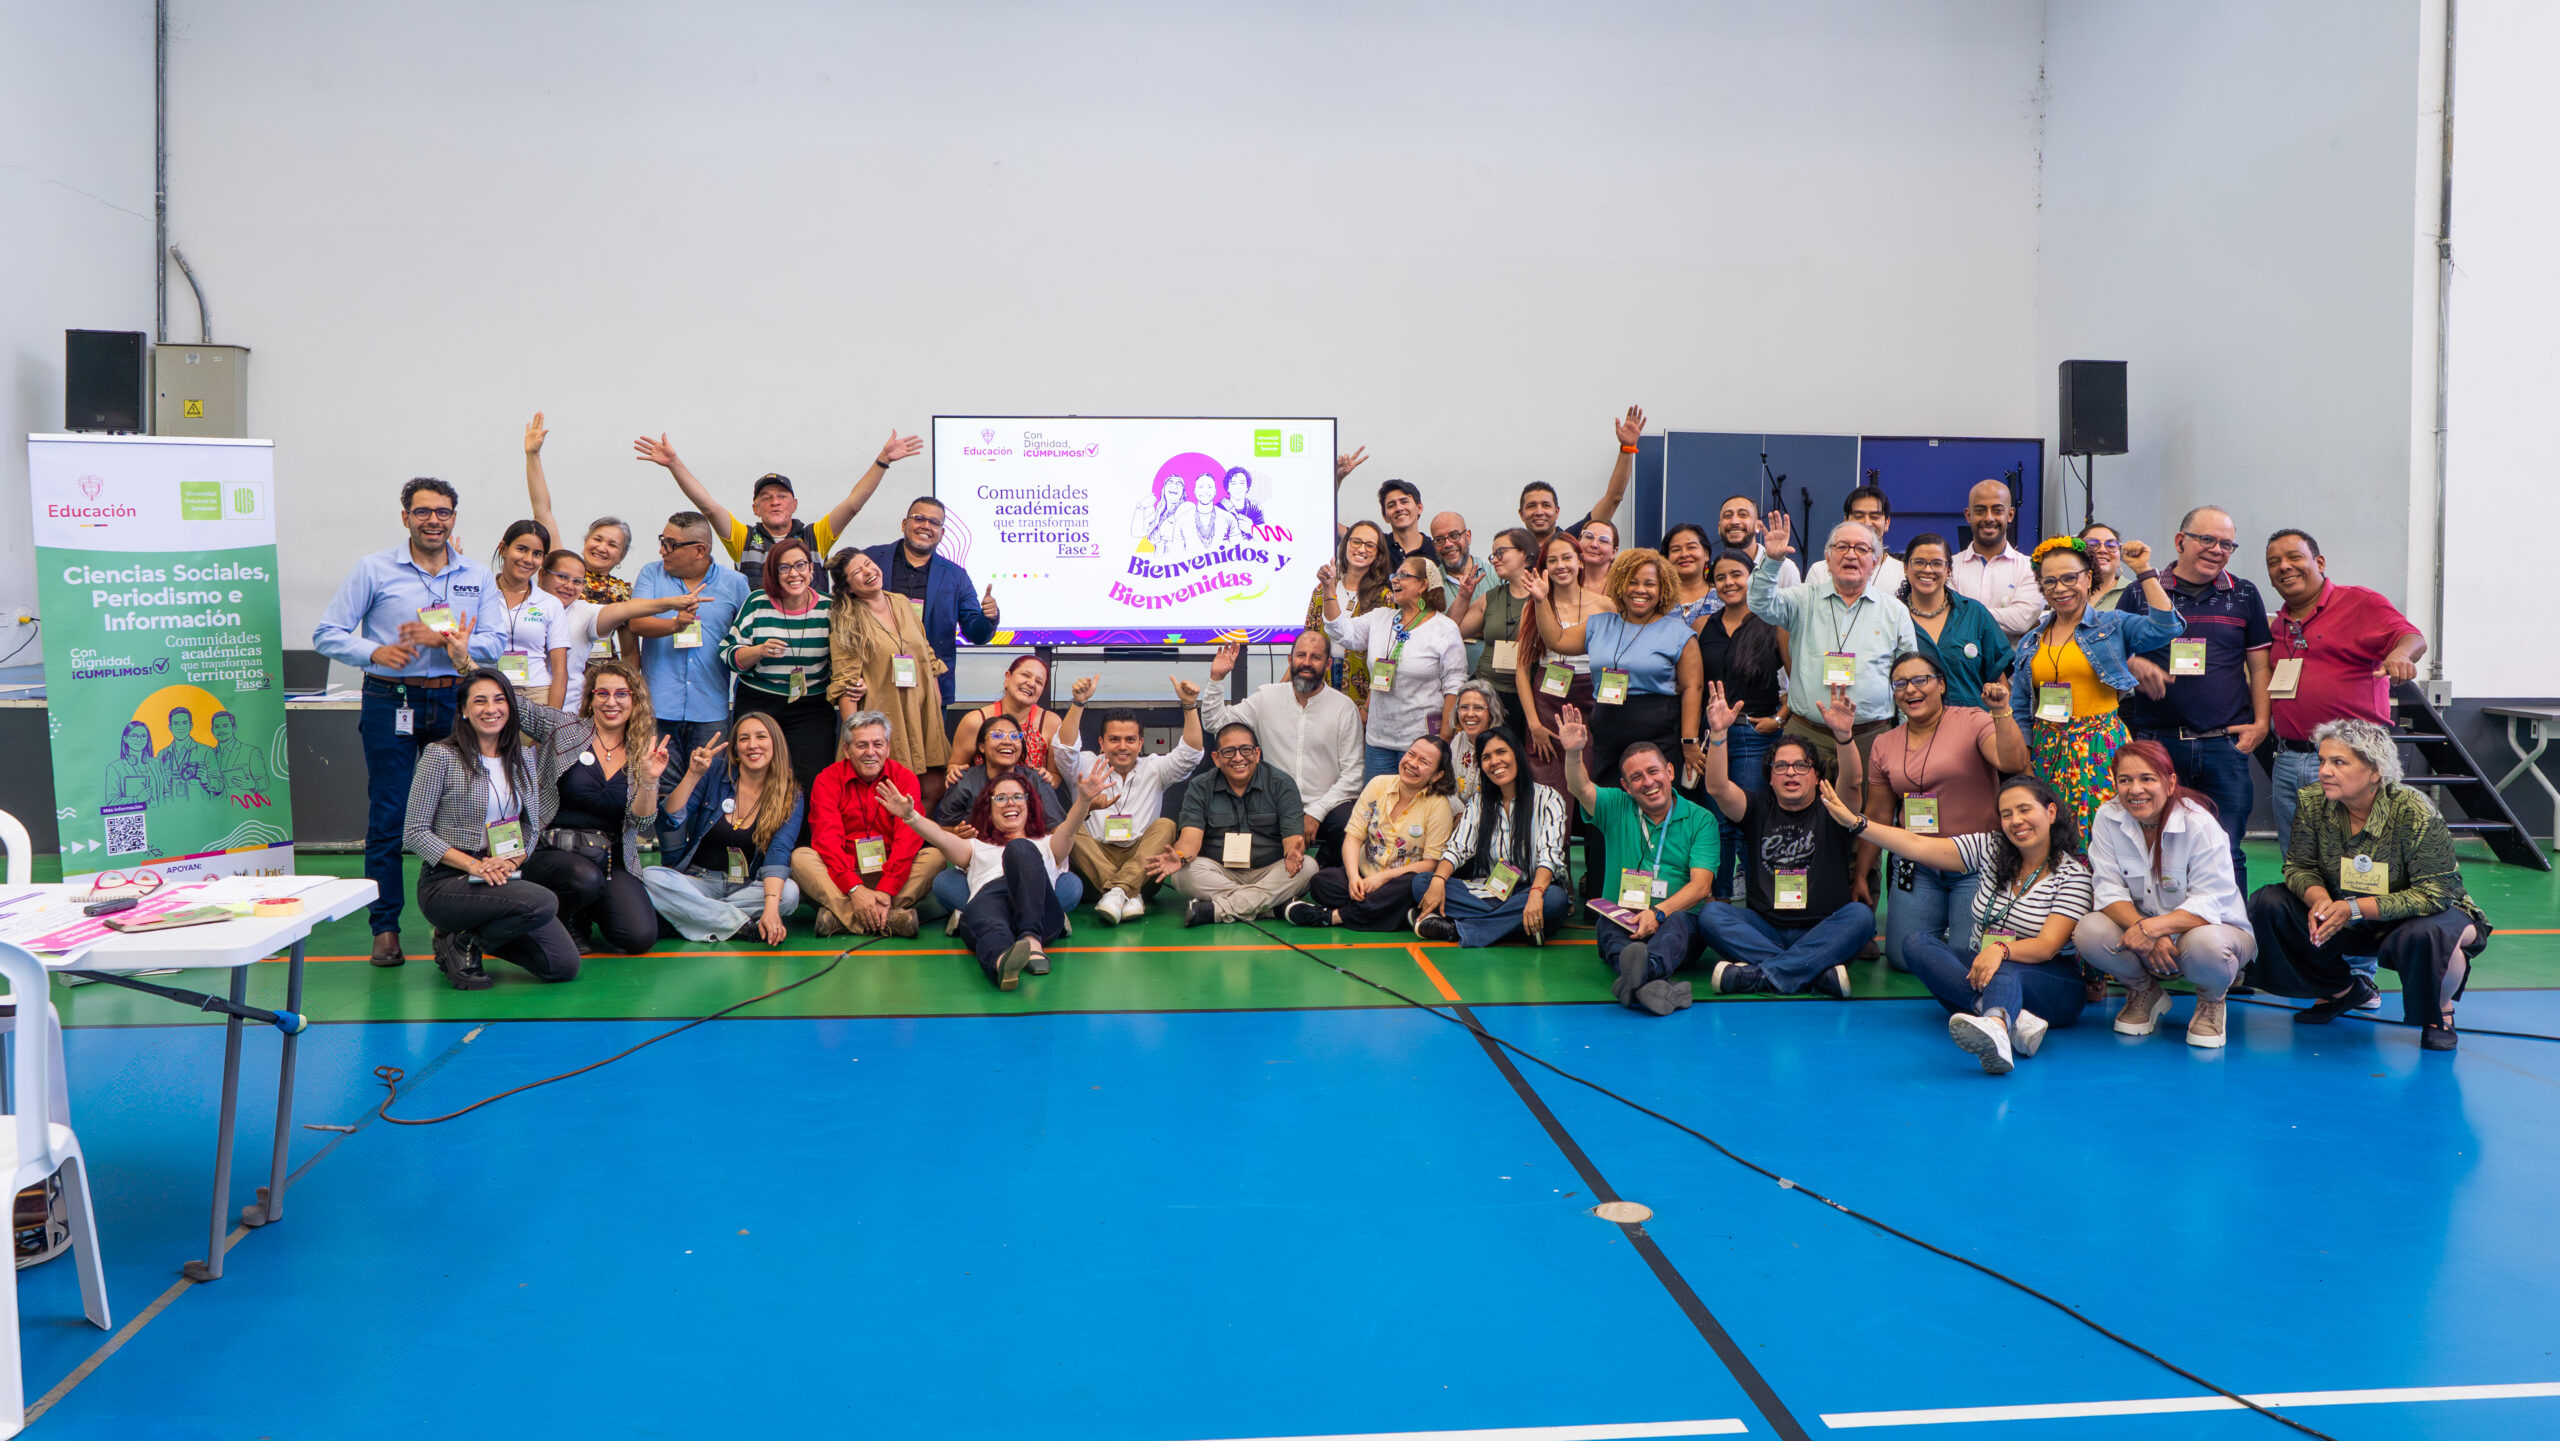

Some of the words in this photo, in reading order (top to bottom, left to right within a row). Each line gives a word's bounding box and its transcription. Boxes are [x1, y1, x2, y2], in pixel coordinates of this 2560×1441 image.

[1023, 431, 1043, 440] Con
[963, 446, 1013, 456] Educación
[1024, 440, 1071, 450] Dignidad,
[1023, 449, 1085, 458] ¡CUMPLIMOS!
[977, 484, 1088, 500] Comunidades
[48, 503, 136, 518] Educación
[995, 501, 1089, 515] académicas
[993, 518, 1015, 531] que
[1018, 516, 1089, 528] transforman
[1000, 528, 1090, 543] territorios
[1058, 543, 1087, 555] Fase
[1090, 543, 1100, 555] 2
[1127, 543, 1269, 579] Bienvenidos
[1274, 553, 1292, 572] y
[63, 563, 167, 585] Ciencias
[172, 562, 270, 583] Sociales,
[92, 587, 222, 608] Periodismo
[228, 589, 243, 603] e
[1108, 570, 1253, 610] Bienvenidas
[104, 608, 241, 632] Información
[165, 631, 261, 648] Comunidades
[70, 648, 97, 658] Con
[181, 645, 263, 660] académicas
[71, 655, 135, 670] Dignidad,
[180, 661, 199, 672] que
[201, 658, 263, 669] transforman
[72, 666, 153, 680] ¡CUMPLIMOS!
[187, 666, 264, 682] territorios
[235, 679, 263, 689] Fase
[263, 677, 271, 688] 2
[166, 863, 202, 874] APOYAN:
